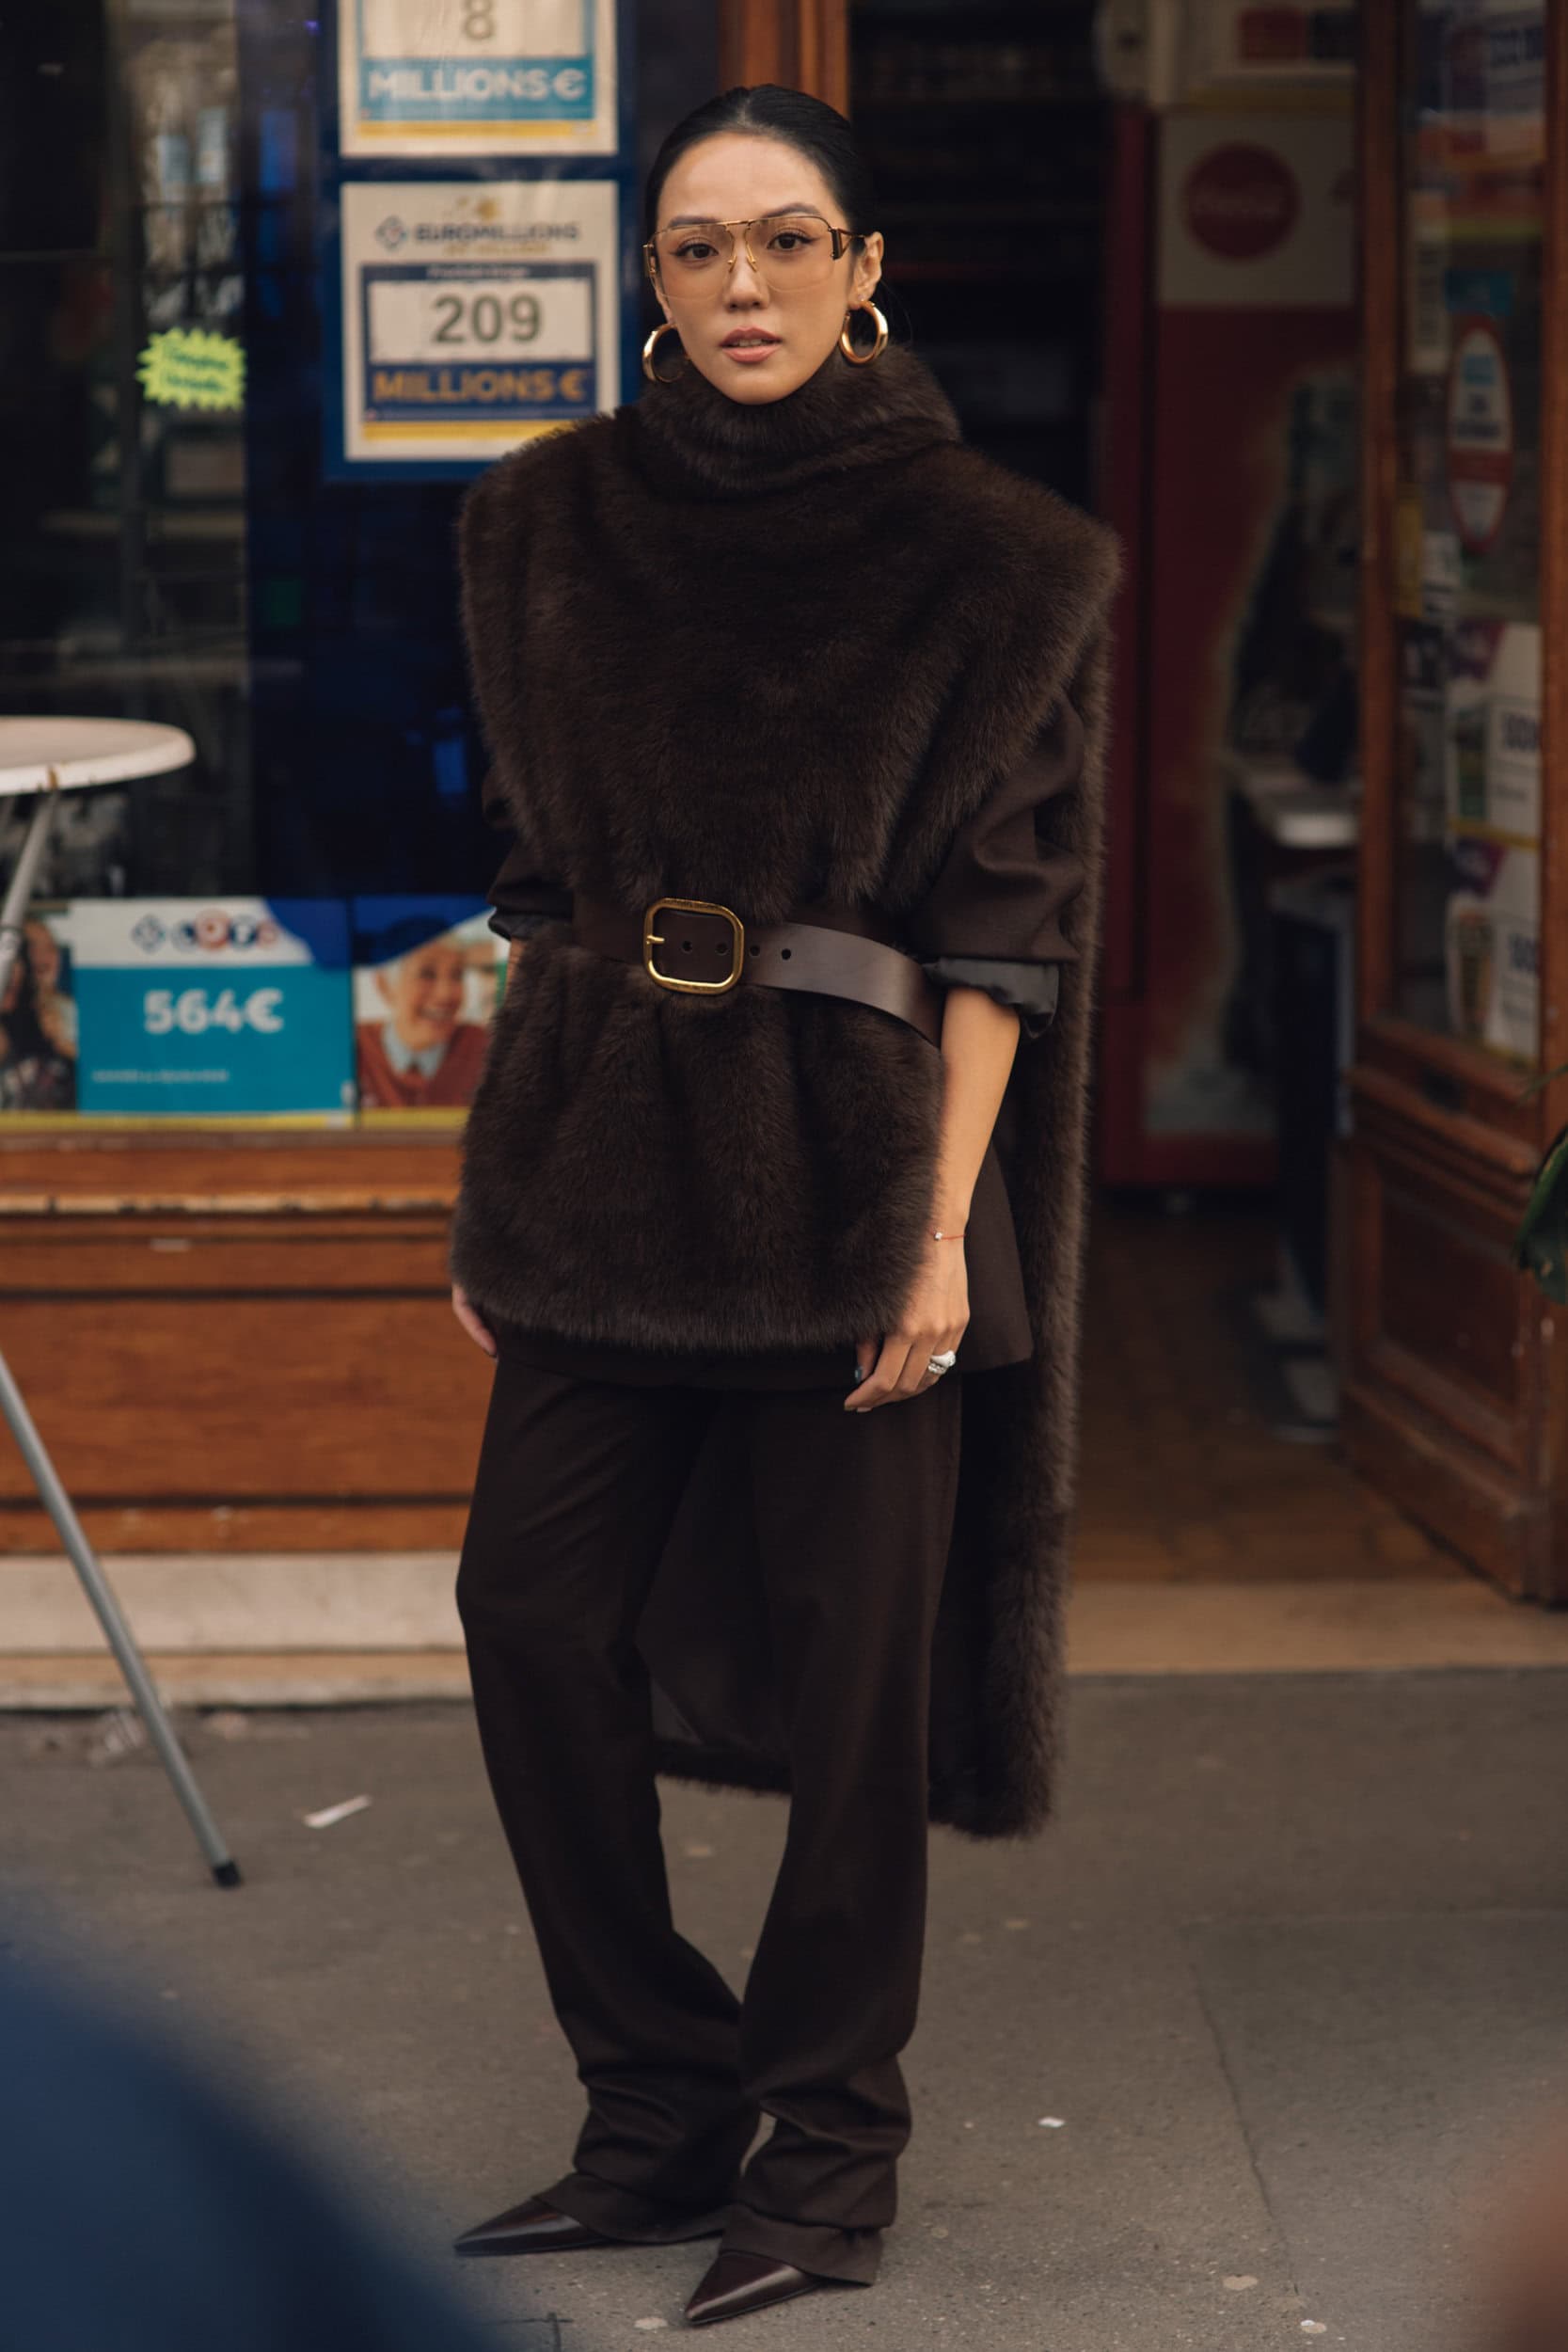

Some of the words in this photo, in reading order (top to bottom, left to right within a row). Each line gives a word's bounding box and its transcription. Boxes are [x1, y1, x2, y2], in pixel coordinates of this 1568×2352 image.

[462, 0, 496, 40] 8
[433, 294, 542, 344] 209
[144, 988, 284, 1033] 564€
